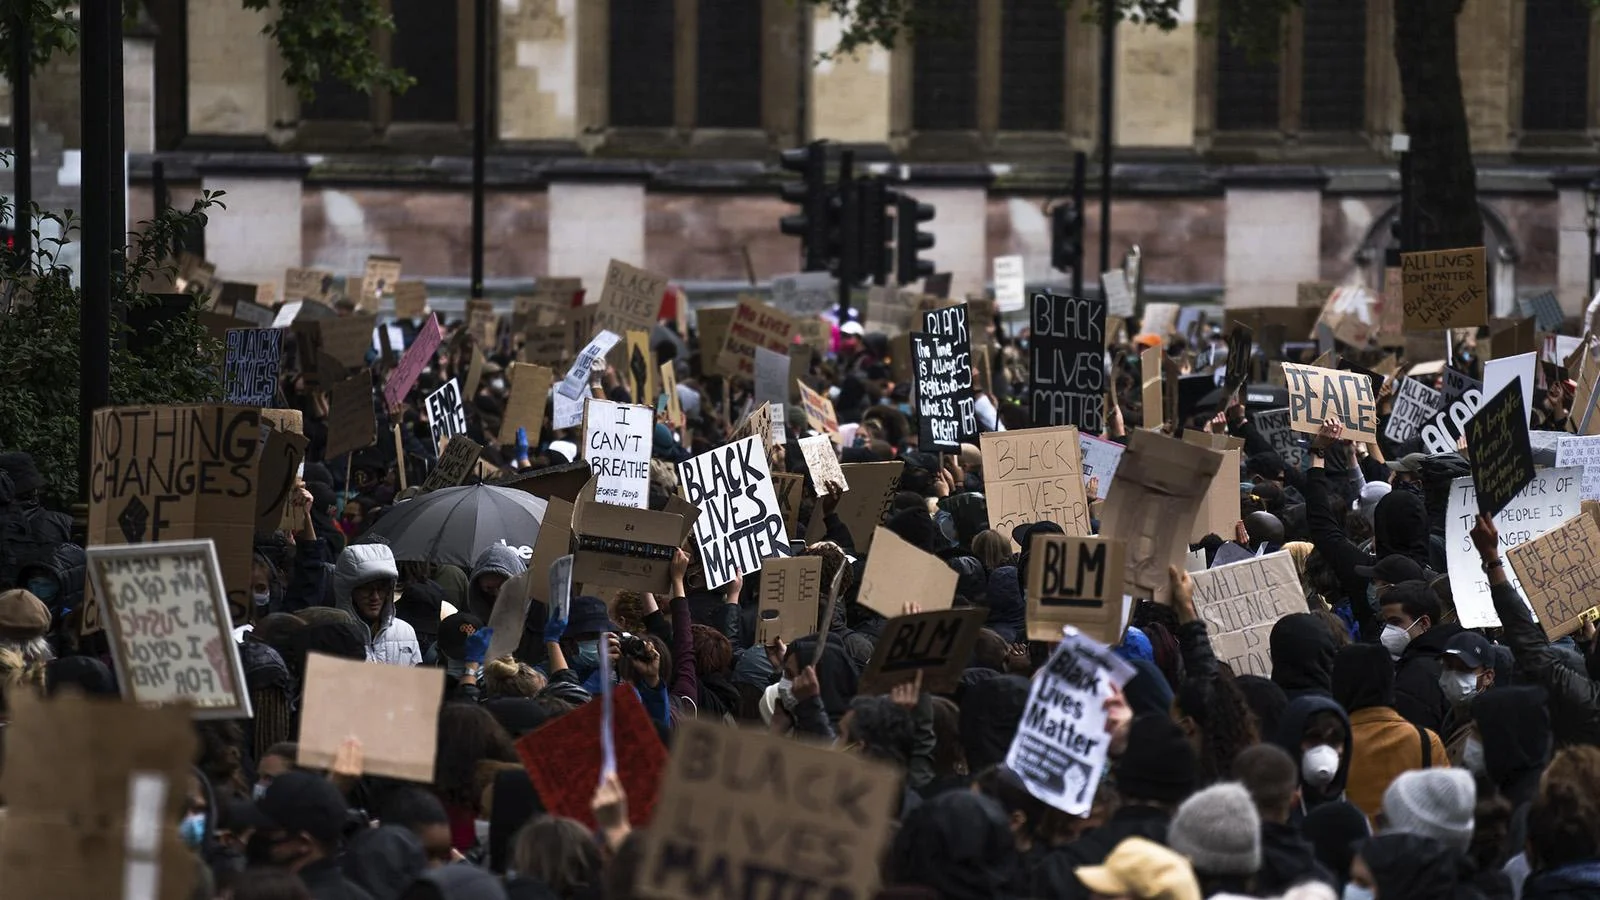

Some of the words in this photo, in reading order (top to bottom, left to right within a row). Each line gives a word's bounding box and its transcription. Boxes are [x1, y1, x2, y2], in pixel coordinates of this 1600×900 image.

[609, 266, 658, 296] BLACK
[1403, 254, 1430, 272] ALL
[1434, 253, 1475, 269] LIVES
[609, 291, 654, 318] LIVES
[1034, 294, 1102, 343] BLACK
[226, 328, 281, 362] BLACK
[224, 361, 279, 398] LIVES
[1035, 347, 1102, 391] LIVES
[429, 383, 457, 422] END
[1033, 389, 1104, 431] MATTER
[1396, 396, 1409, 417] TO
[1408, 402, 1430, 425] THE
[1400, 380, 1418, 400] ALL
[93, 406, 259, 464] NOTHING
[615, 406, 630, 426] I
[931, 418, 959, 441] RIGHT
[958, 397, 977, 434] TER
[590, 431, 642, 452] CAN'T
[993, 439, 1073, 479] BLACK
[91, 457, 251, 504] CHANGES
[591, 456, 649, 479] BREATHE
[683, 438, 765, 506] BLACK
[1556, 477, 1573, 493] OF
[621, 489, 640, 501] FLOYD
[696, 483, 767, 545] LIVES
[1001, 479, 1068, 519] LIVES
[1501, 508, 1540, 522] PEOPLE
[1550, 504, 1562, 517] IS
[703, 514, 792, 588] MATTER
[1462, 531, 1530, 552] SNGER
[1513, 540, 1546, 568] THE
[1545, 518, 1587, 554] LEAST
[1526, 536, 1595, 588] RACIST
[1042, 541, 1106, 597] BLM
[1194, 558, 1281, 603] WHITE
[1203, 587, 1286, 635] SILENCE
[886, 618, 962, 661] BLM
[1048, 650, 1102, 696] Black
[1037, 672, 1083, 719] Lives
[1024, 701, 1098, 757] Matter
[681, 728, 873, 828] BLACK
[674, 796, 852, 877] LIVES
